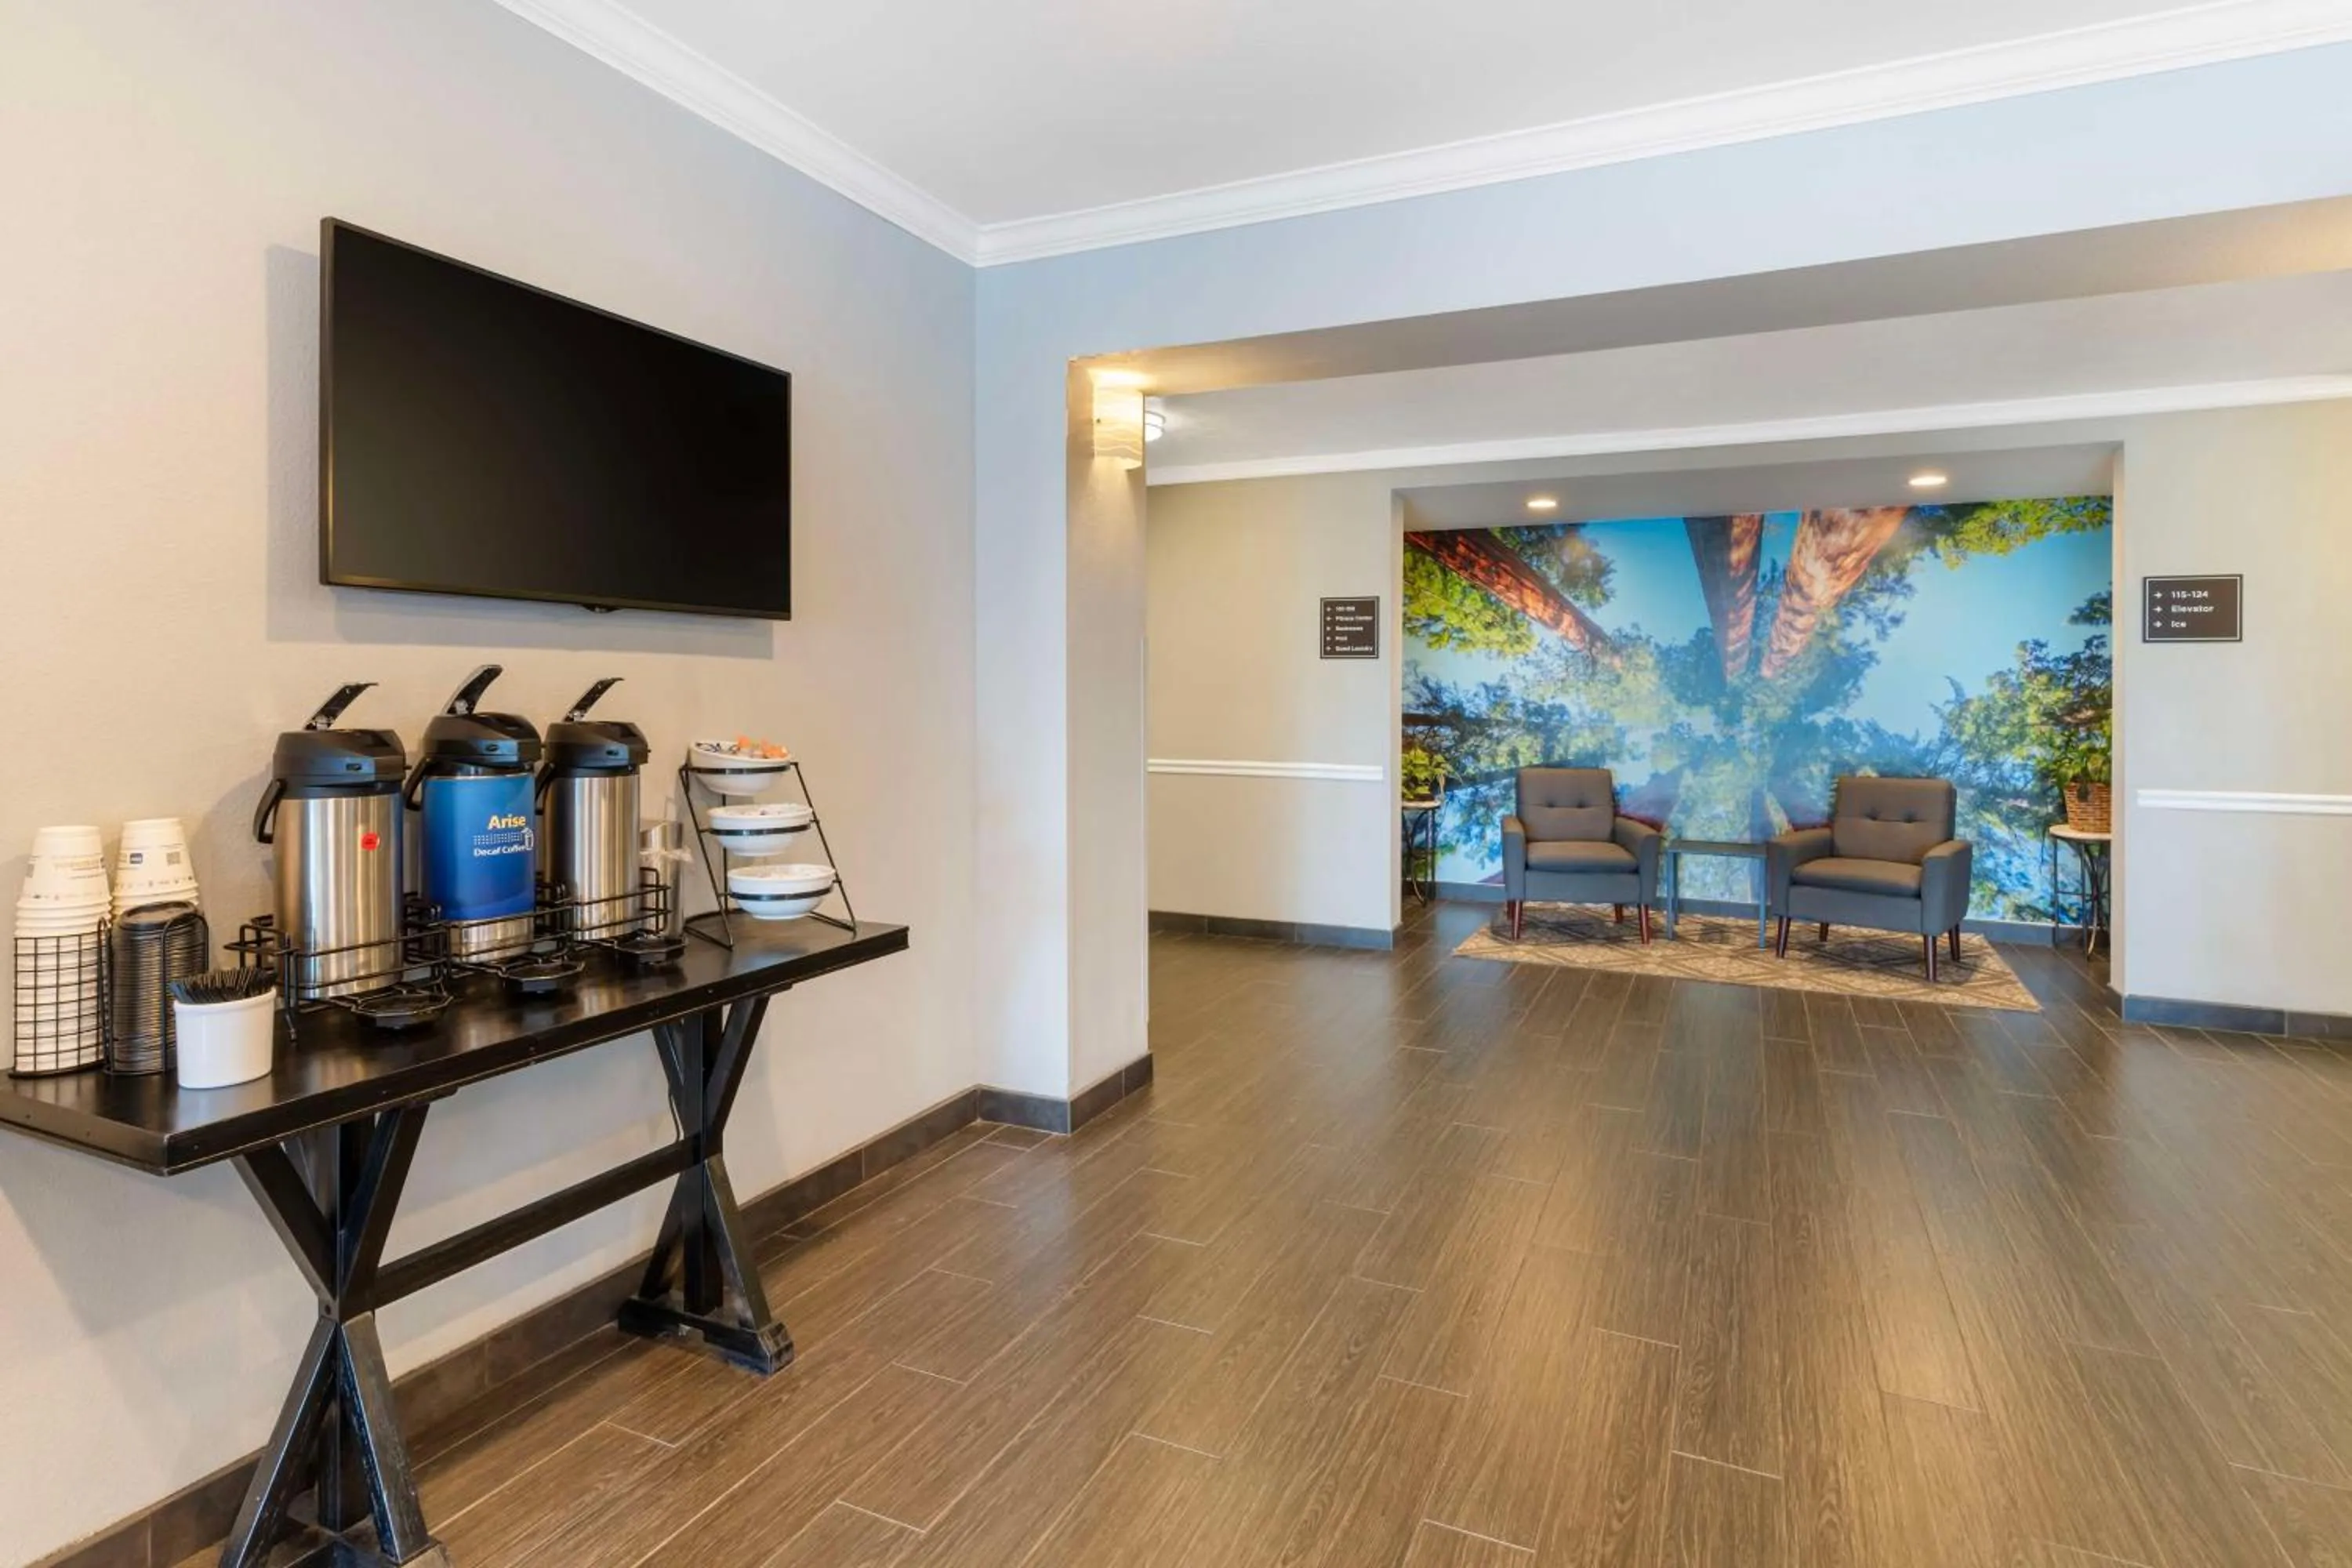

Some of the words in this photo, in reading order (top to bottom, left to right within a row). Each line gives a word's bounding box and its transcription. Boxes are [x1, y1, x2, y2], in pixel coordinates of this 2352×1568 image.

[2171, 604, 2214, 613] Elevator
[488, 814, 526, 829] Arise
[474, 847, 501, 857] Decaf
